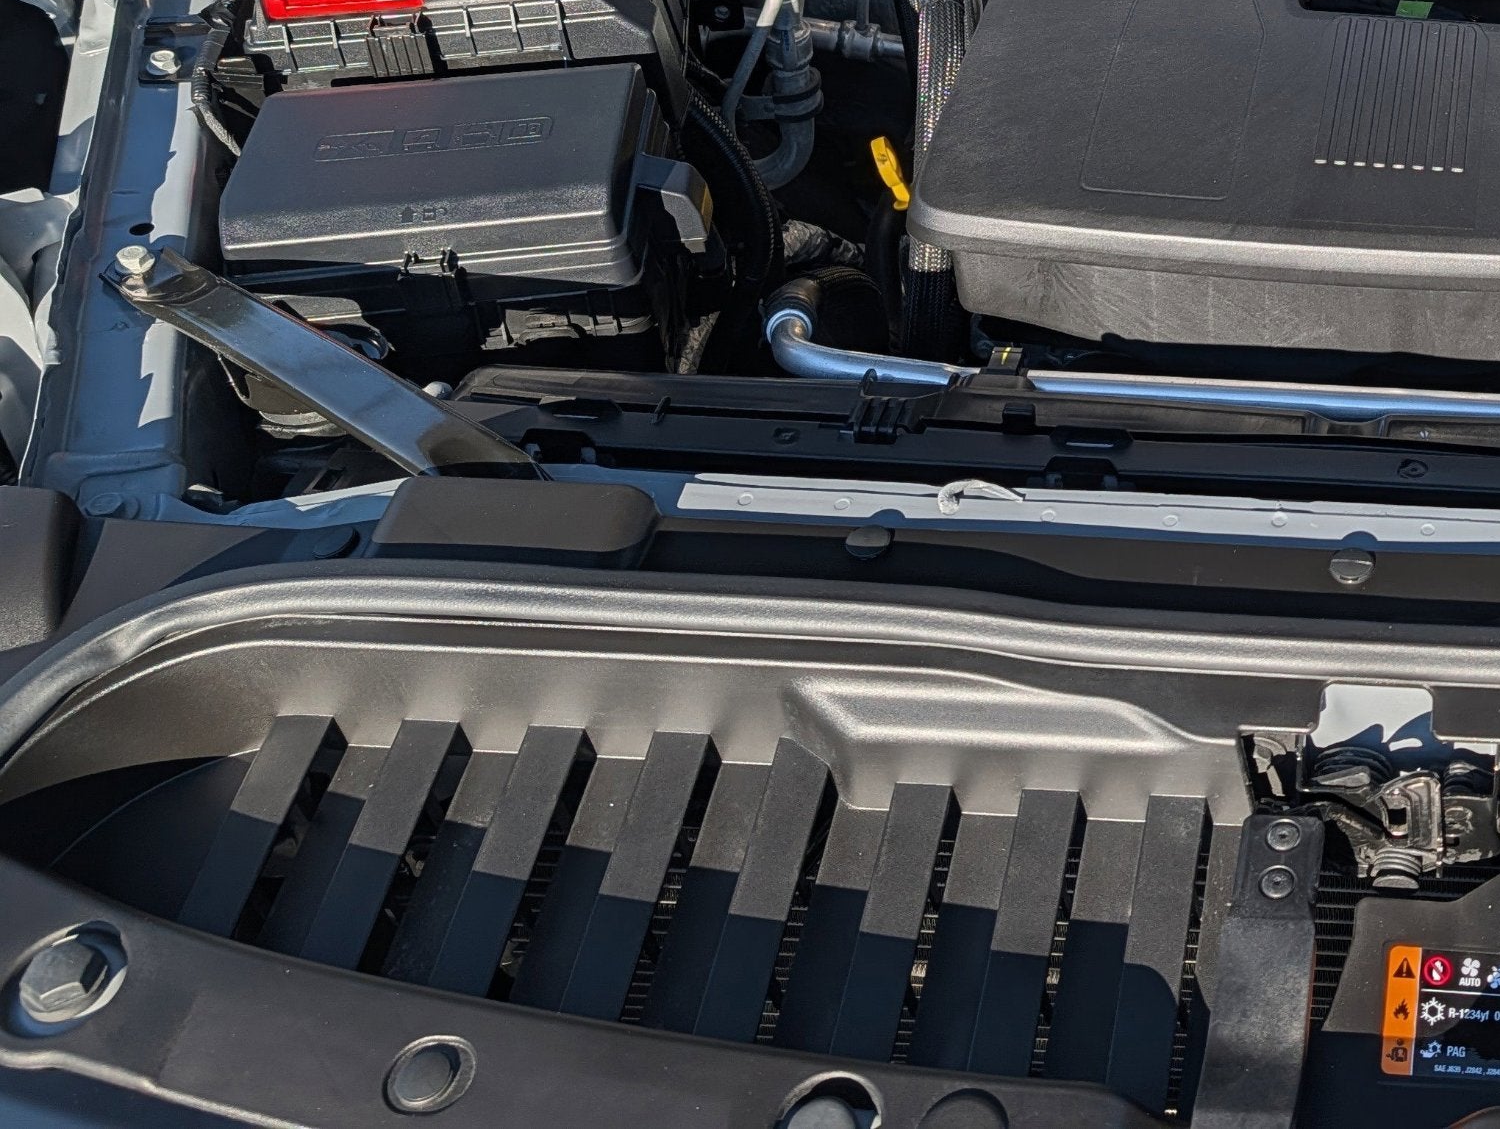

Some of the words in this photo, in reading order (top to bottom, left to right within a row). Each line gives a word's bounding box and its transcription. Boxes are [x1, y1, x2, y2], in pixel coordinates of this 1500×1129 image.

[1459, 977, 1481, 987] AUTO
[1448, 1008, 1489, 1022] R-1234yf
[1446, 1046, 1466, 1057] PAG
